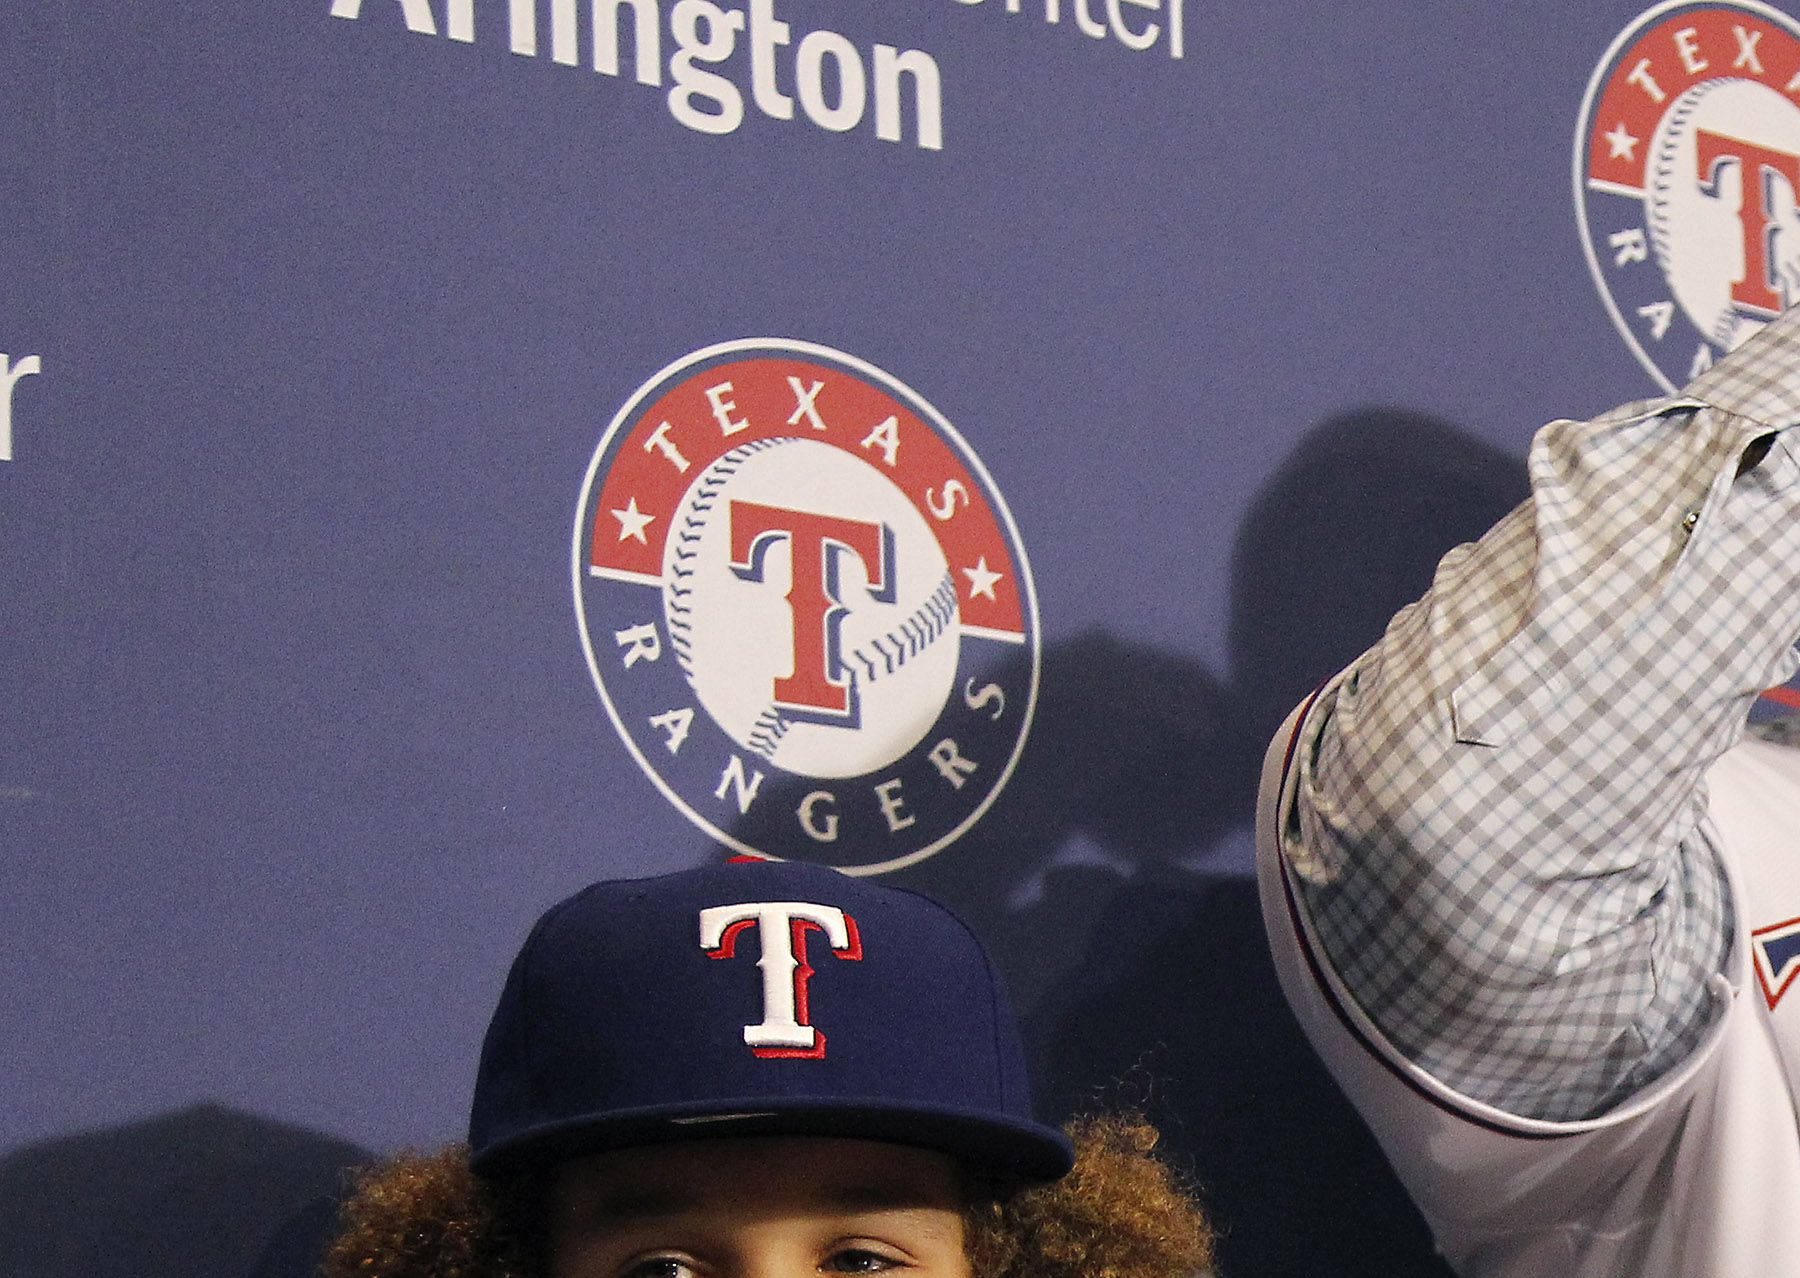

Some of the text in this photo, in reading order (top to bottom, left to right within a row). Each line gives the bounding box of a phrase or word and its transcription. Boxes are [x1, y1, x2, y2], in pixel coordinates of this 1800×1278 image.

[329, 0, 943, 151] ngton
[644, 376, 970, 523] TEXAS
[729, 499, 897, 731] T
[616, 621, 1006, 843] RANGERS
[700, 902, 864, 1060] T
